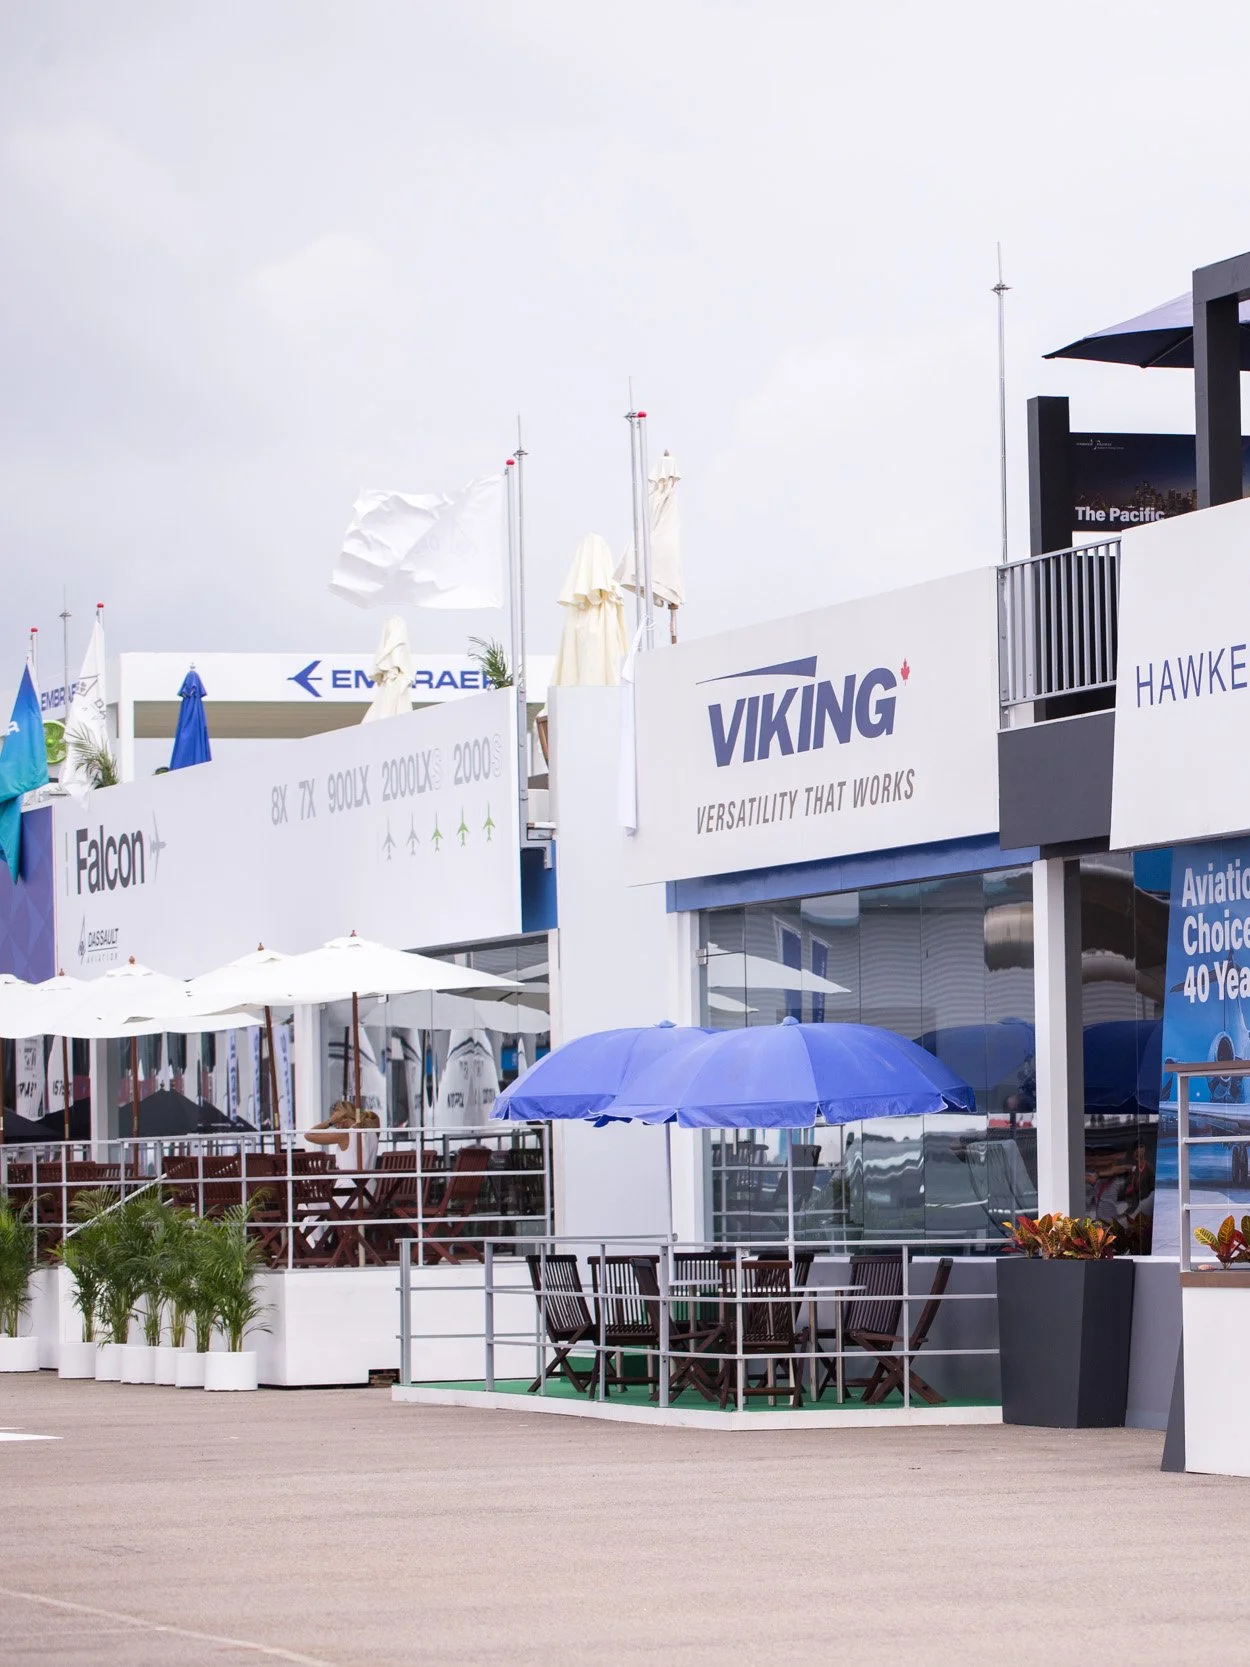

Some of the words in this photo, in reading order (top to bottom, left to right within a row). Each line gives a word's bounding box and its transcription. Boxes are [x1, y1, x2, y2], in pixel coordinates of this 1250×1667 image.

[1075, 507, 1106, 521] The
[1109, 507, 1165, 522] Pacific
[331, 669, 496, 689] EMRAE
[708, 666, 897, 768] VIKING
[271, 784, 288, 826] 8X
[299, 779, 316, 820] 7X
[328, 764, 371, 813] 900LX
[697, 789, 799, 835] VERSATILITY
[804, 781, 847, 817] THAT
[852, 768, 916, 809] WORKS
[76, 825, 145, 895] Falcon
[87, 928, 119, 948] DASSAULT
[1183, 966, 1210, 1003] 40
